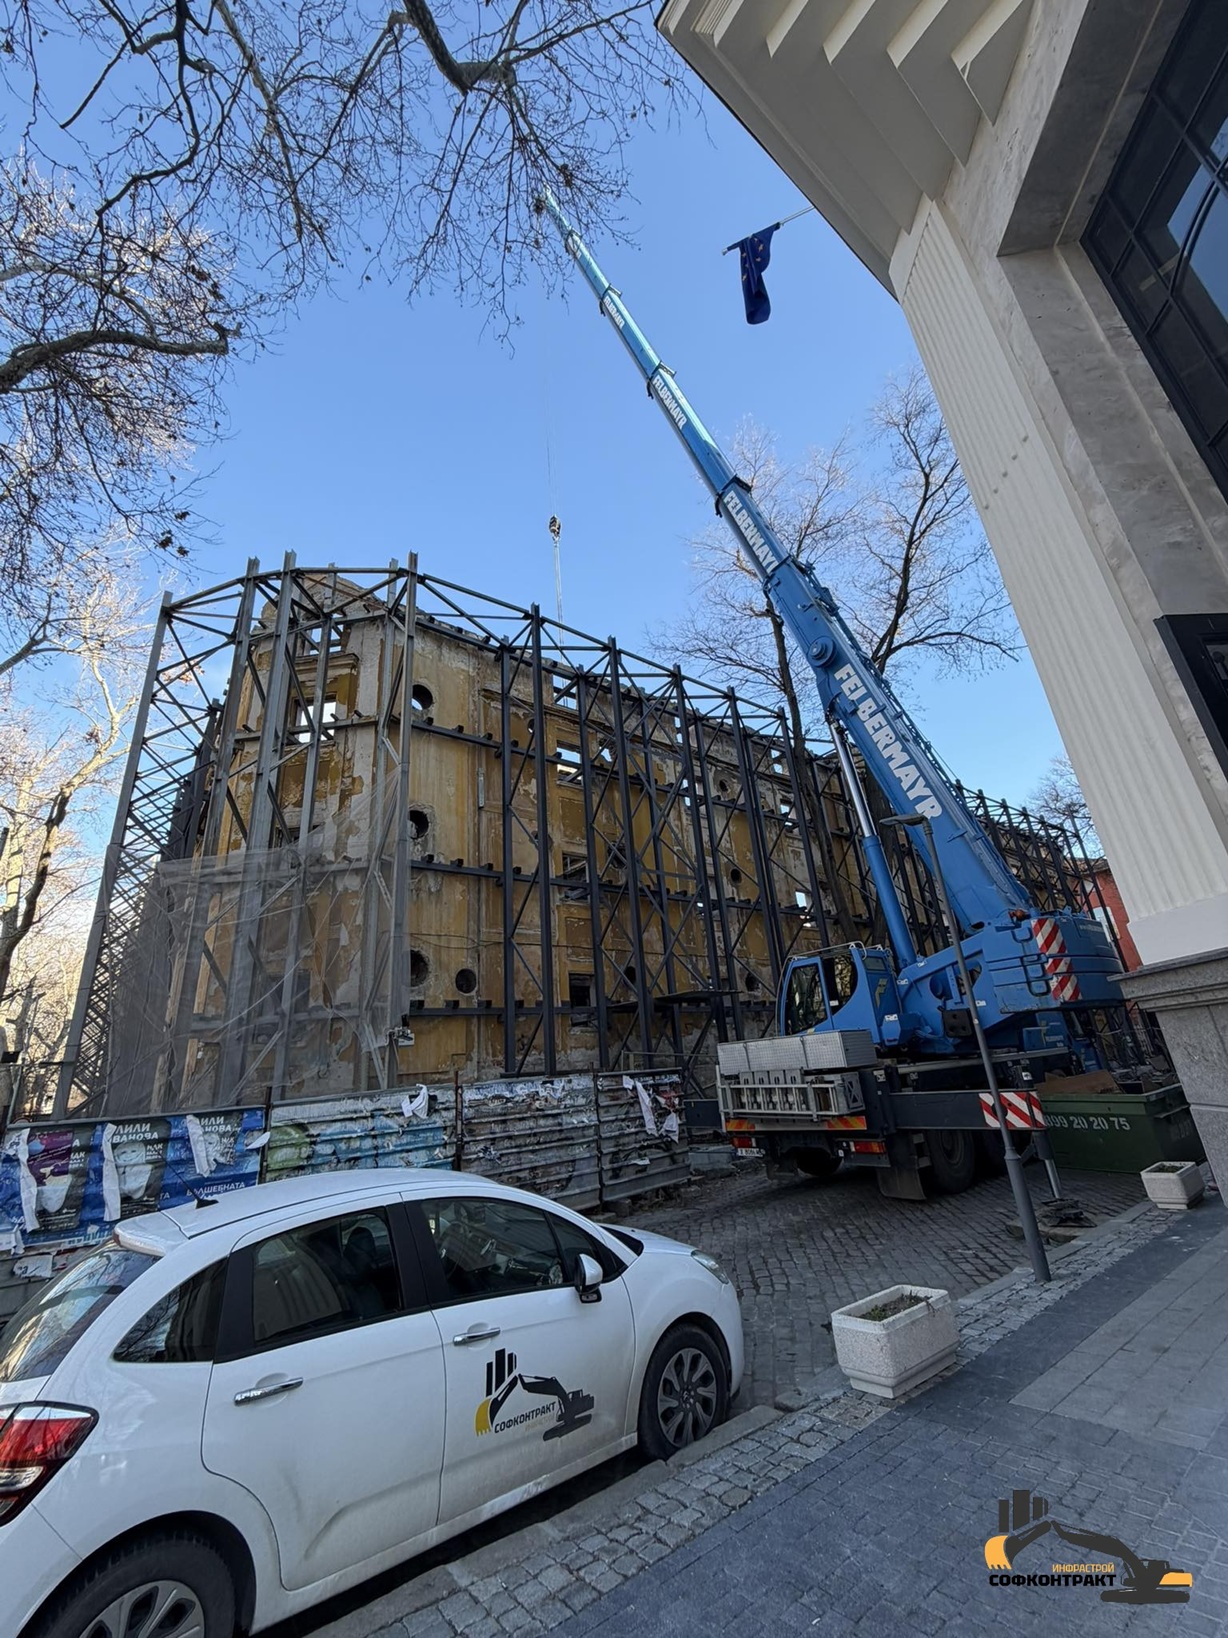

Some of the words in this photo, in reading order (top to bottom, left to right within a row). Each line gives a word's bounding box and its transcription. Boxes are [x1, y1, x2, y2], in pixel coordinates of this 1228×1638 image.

[652, 374, 687, 430] FELBERMAYR
[834, 663, 942, 819] FELBERMAYR
[115, 1123, 151, 1134] ЛИЛИ
[1070, 1116, 1088, 1130] 20
[1089, 1116, 1109, 1130] 20
[1109, 1117, 1131, 1131] 75
[111, 1131, 159, 1143] ВАНОВА
[494, 1401, 556, 1433] СОФКОНТРАКТ
